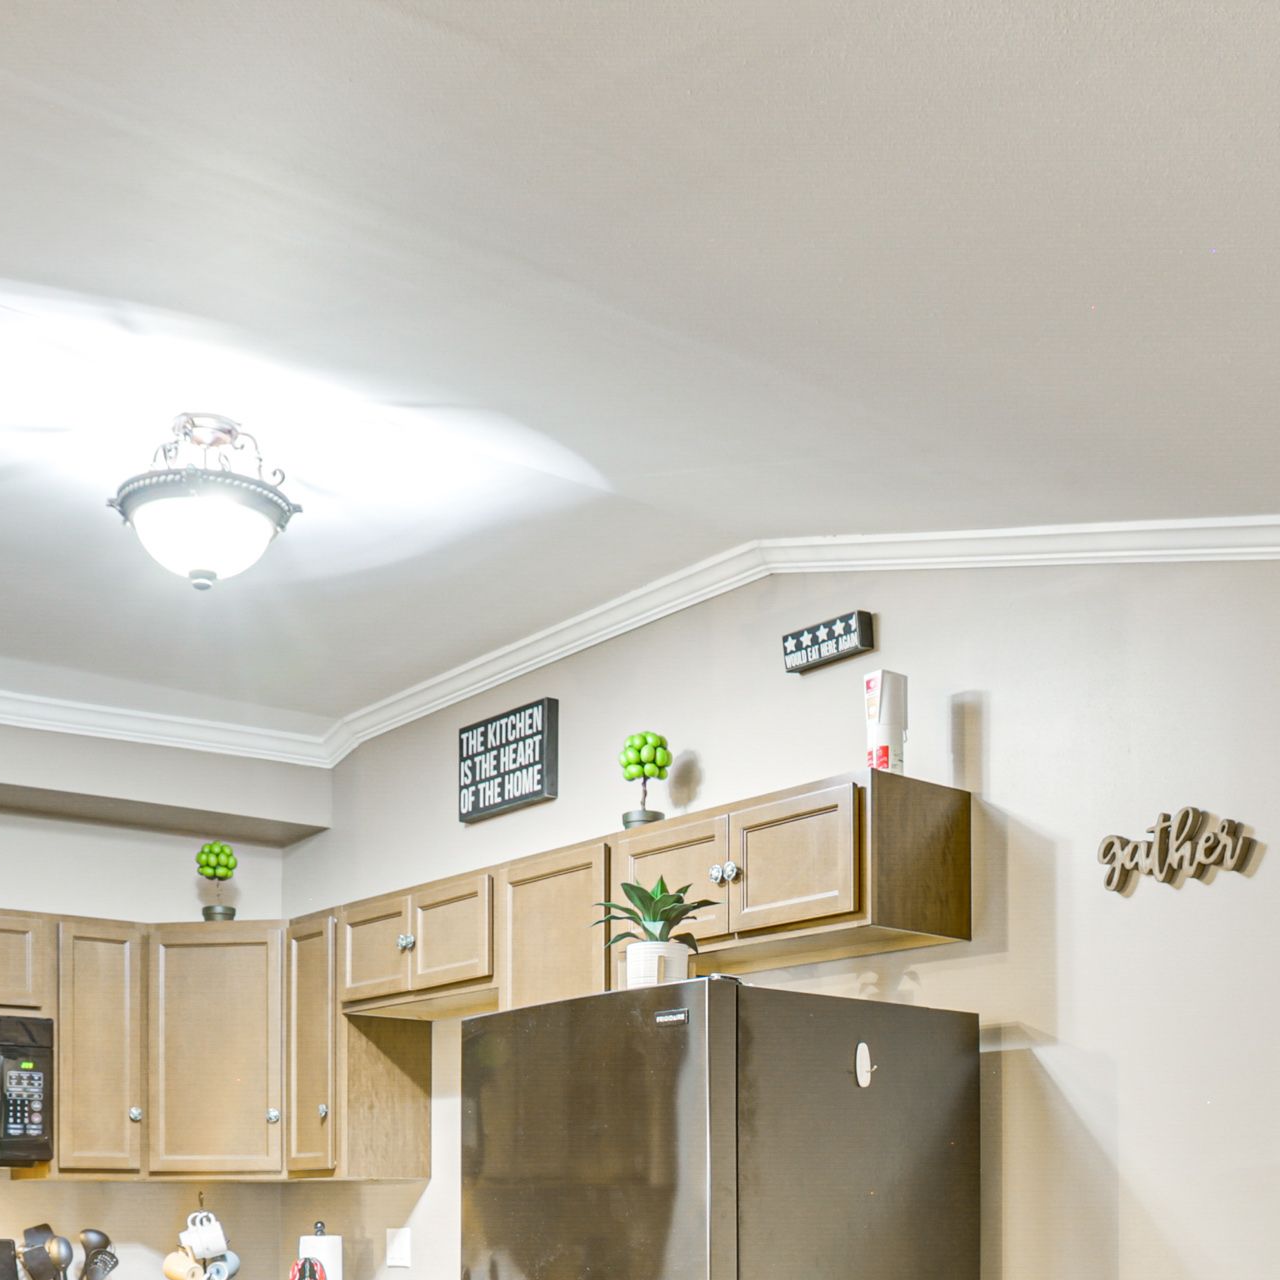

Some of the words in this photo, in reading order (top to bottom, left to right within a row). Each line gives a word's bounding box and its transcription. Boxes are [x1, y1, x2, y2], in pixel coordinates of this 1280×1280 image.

[785, 649, 808, 669] WOULD
[807, 645, 820, 662] EAT
[820, 638, 838, 658] HERE
[461, 727, 485, 758] THE
[487, 704, 543, 749] KITCHEN
[460, 759, 473, 786] IS
[474, 750, 498, 781] THE
[500, 734, 542, 773] HEART
[460, 785, 476, 814] OF
[478, 777, 502, 809] THE
[504, 764, 542, 801] HOME
[1097, 806, 1252, 892] gather
